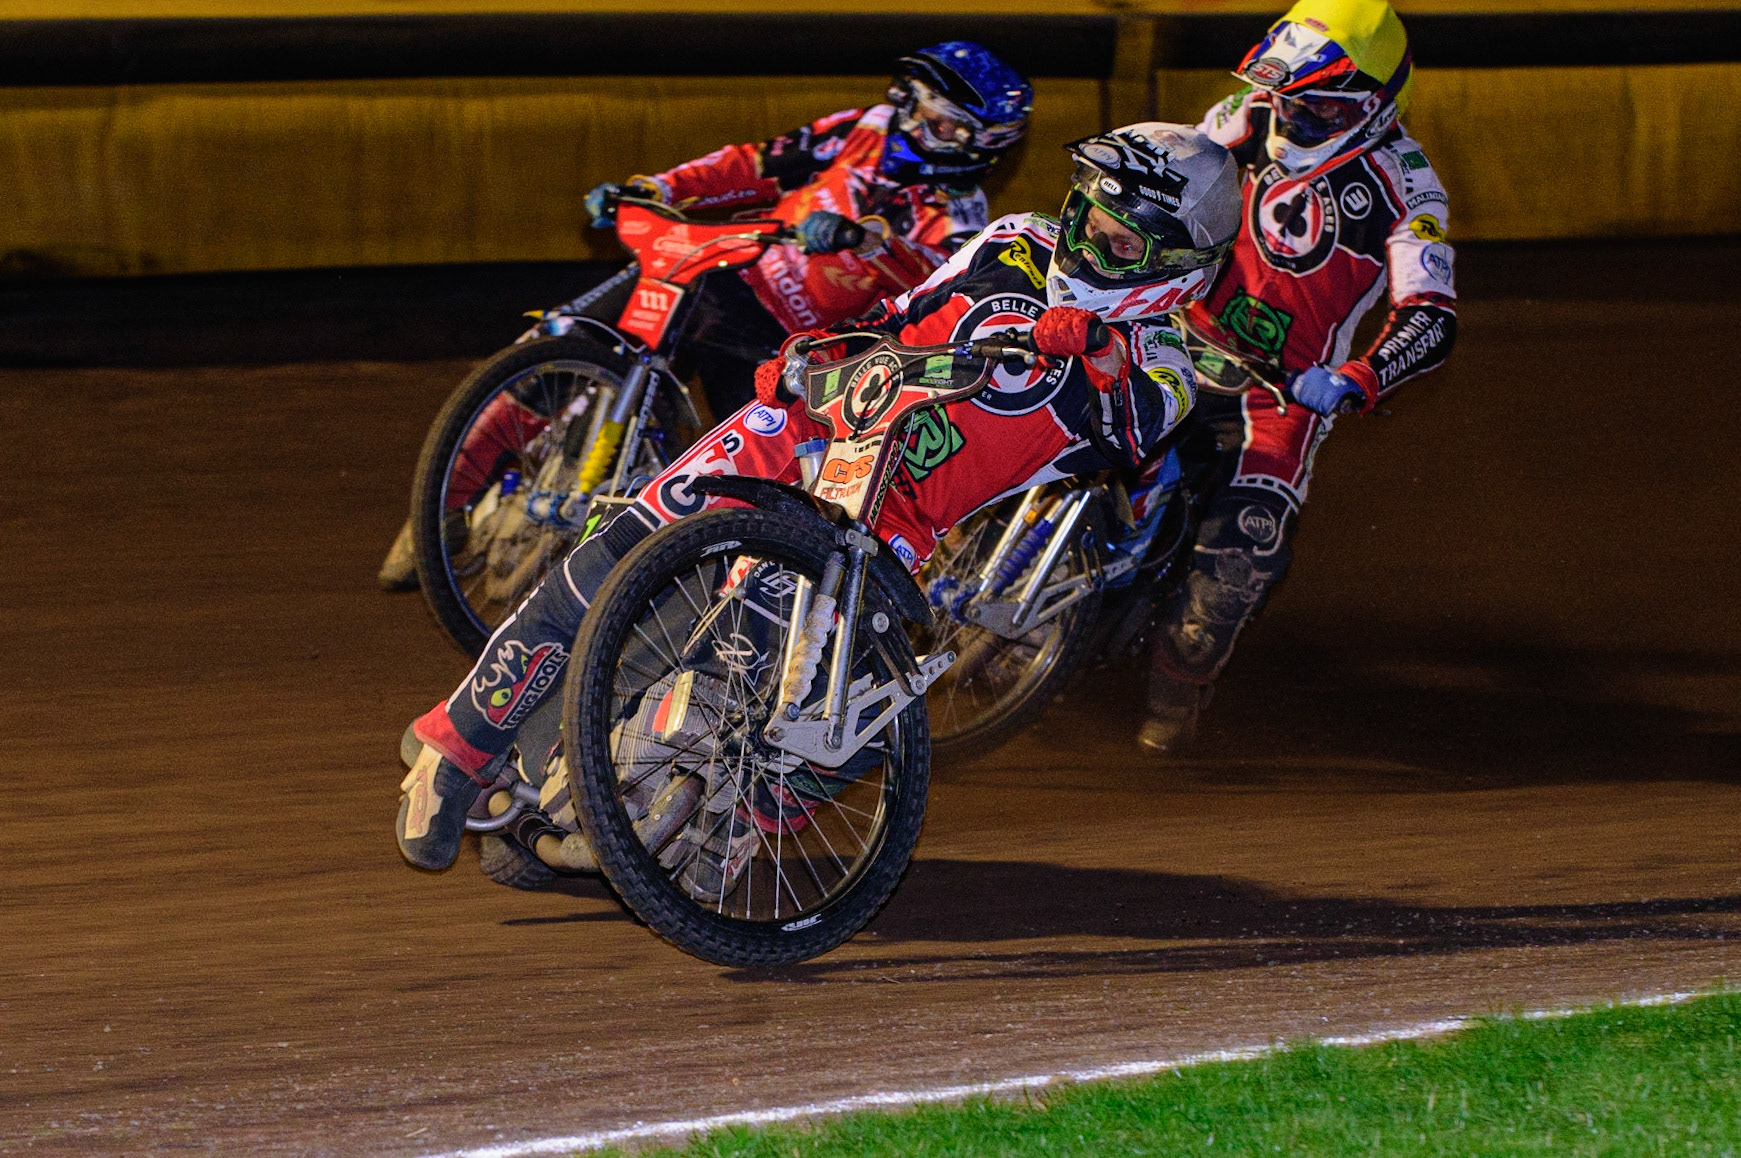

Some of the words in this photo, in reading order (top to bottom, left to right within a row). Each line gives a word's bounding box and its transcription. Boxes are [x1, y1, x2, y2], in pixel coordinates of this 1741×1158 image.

[1104, 180, 1118, 192] BELL
[1138, 184, 1158, 201] GOOD
[991, 298, 1039, 318] BELLE
[1378, 310, 1432, 362] PREMIER
[874, 356, 890, 365] VUE
[754, 408, 777, 427] ATPI
